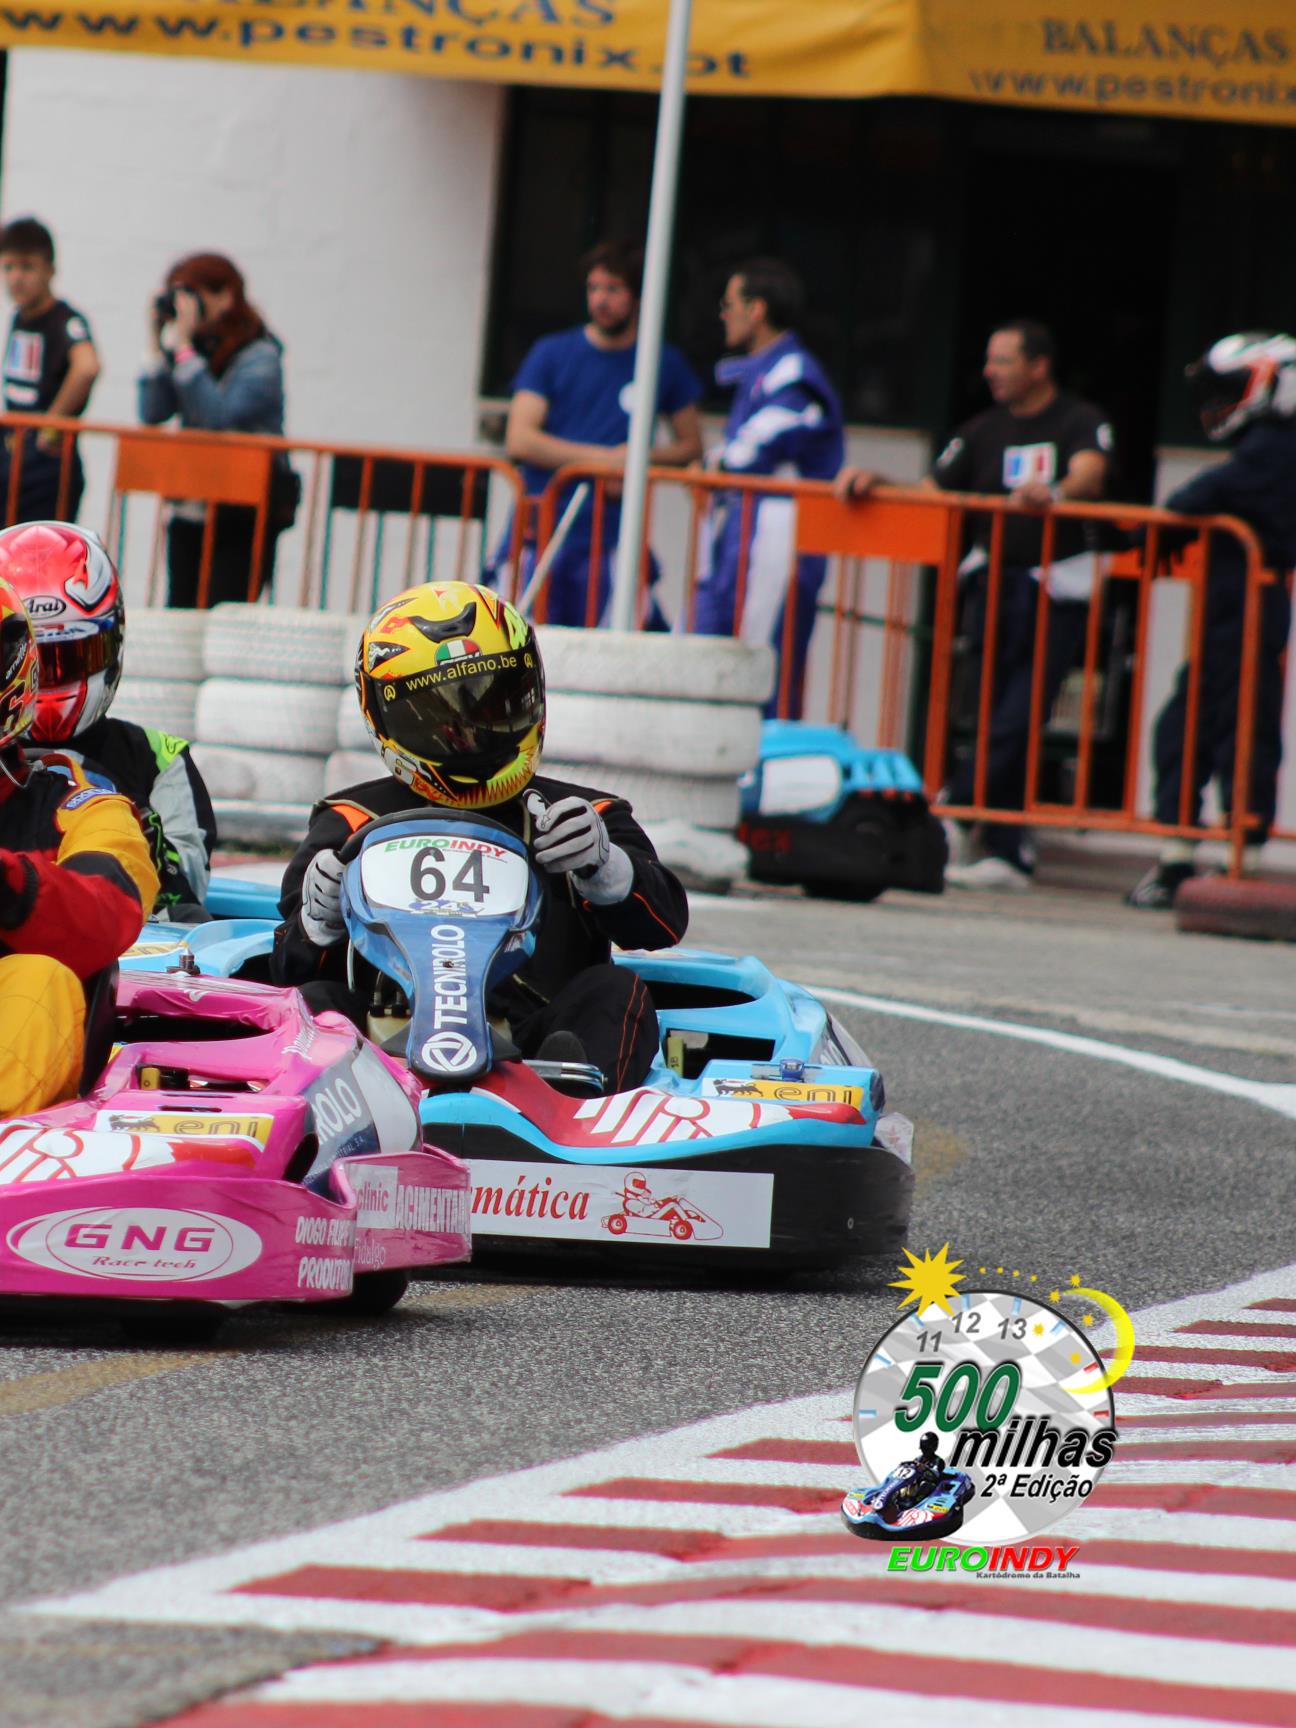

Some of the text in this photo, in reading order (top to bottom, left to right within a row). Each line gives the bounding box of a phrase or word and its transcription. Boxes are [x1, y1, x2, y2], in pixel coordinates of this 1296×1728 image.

[1042, 17, 1290, 69] BALANÇAS
[405, 655, 517, 691] www.alfano.be
[385, 838, 507, 858] EUROINDY
[410, 846, 490, 902] 64
[774, 1086, 852, 1105] eni
[173, 1117, 258, 1136] eni
[469, 1174, 591, 1221] mática
[64, 1222, 215, 1254] GNG
[92, 1255, 197, 1270] Race tech
